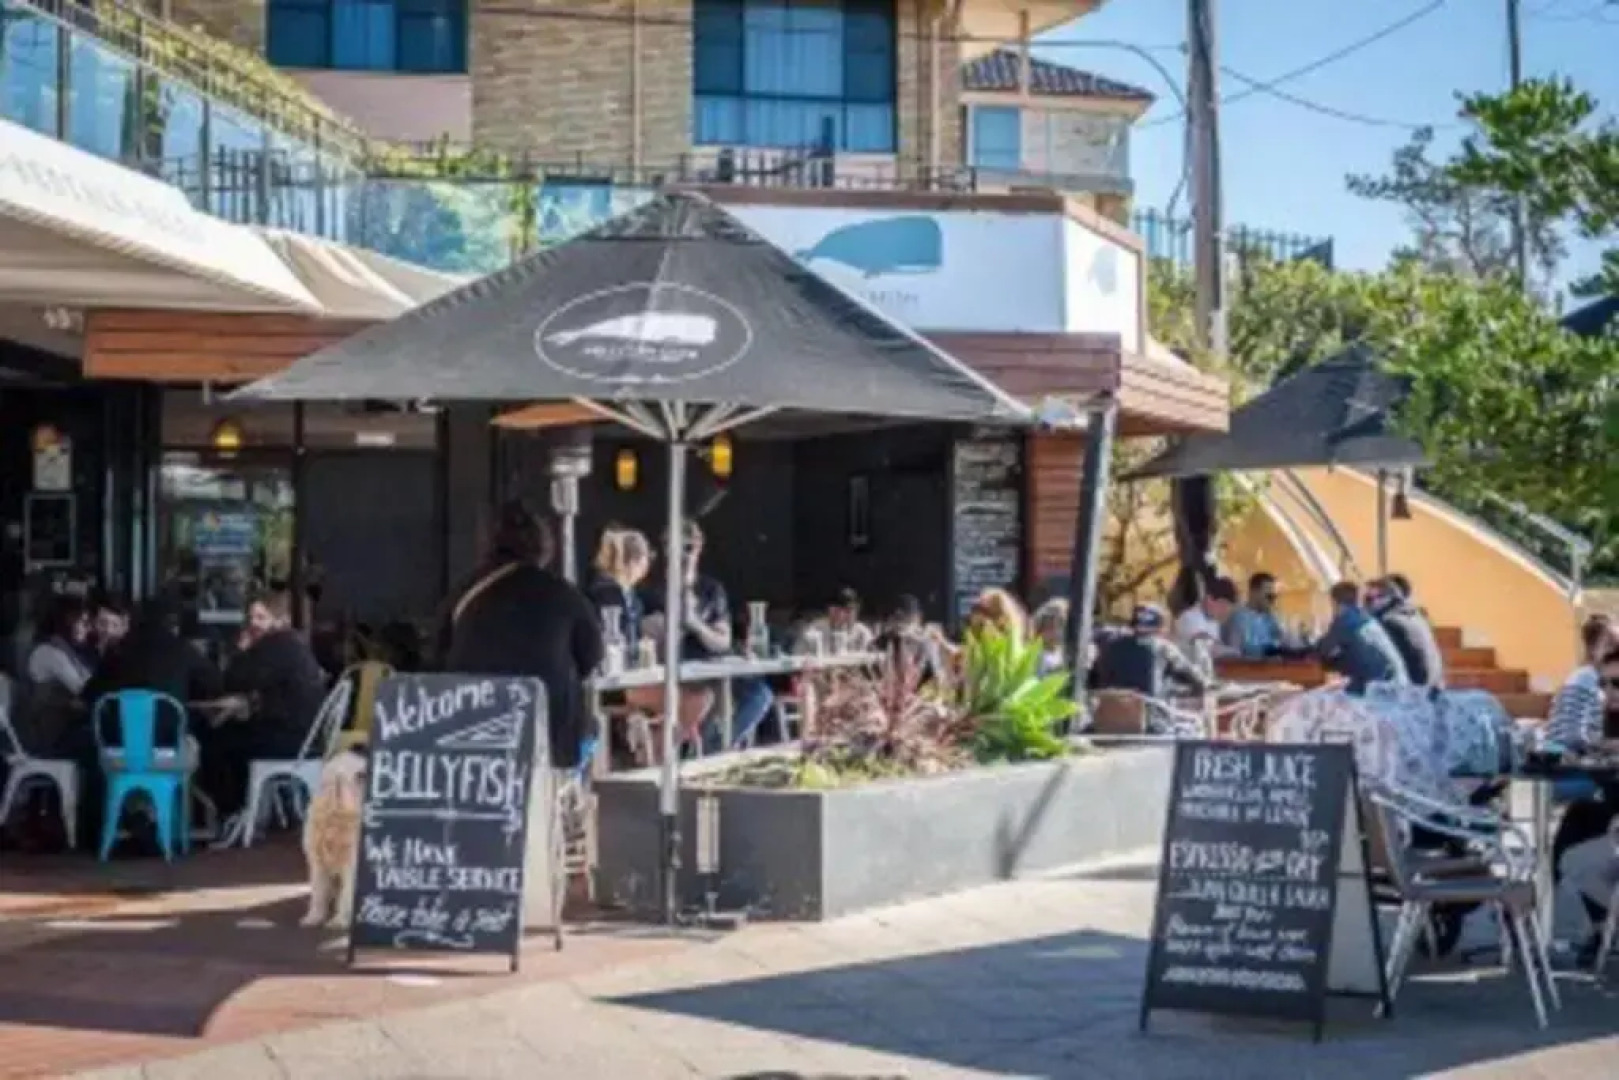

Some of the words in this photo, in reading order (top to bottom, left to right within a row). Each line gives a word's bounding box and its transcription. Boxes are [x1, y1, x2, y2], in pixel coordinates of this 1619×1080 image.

[374, 680, 494, 741] Welcome
[372, 751, 527, 805] BELLYFISH
[375, 866, 440, 890] TABLE
[448, 867, 521, 893] SERVICE
